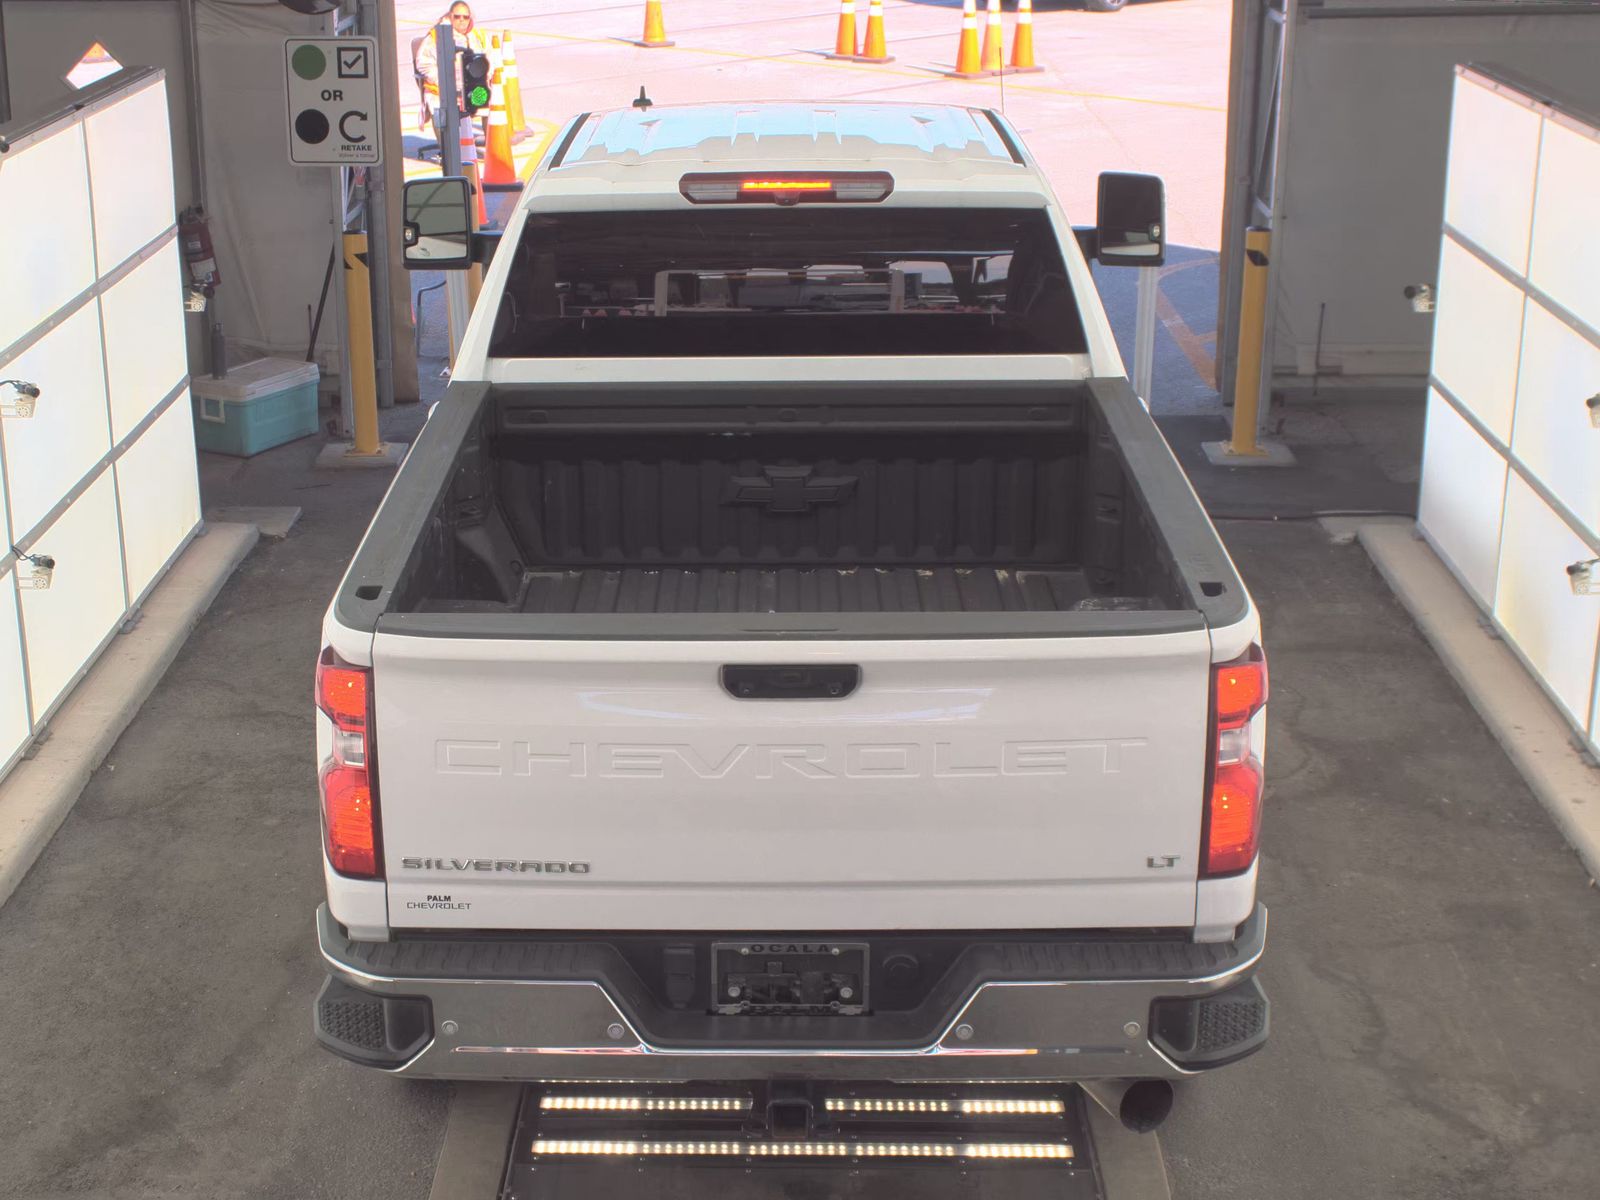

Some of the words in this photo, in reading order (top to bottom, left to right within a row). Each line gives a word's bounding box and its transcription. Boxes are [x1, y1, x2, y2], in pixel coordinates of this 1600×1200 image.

[321, 89, 343, 101] OR
[435, 737, 1148, 778] CHEVROLET
[401, 857, 590, 874] SILVERADO
[1146, 854, 1181, 868] LT
[406, 902, 472, 910] CHEVROLET
[751, 944, 829, 953] OCALA
